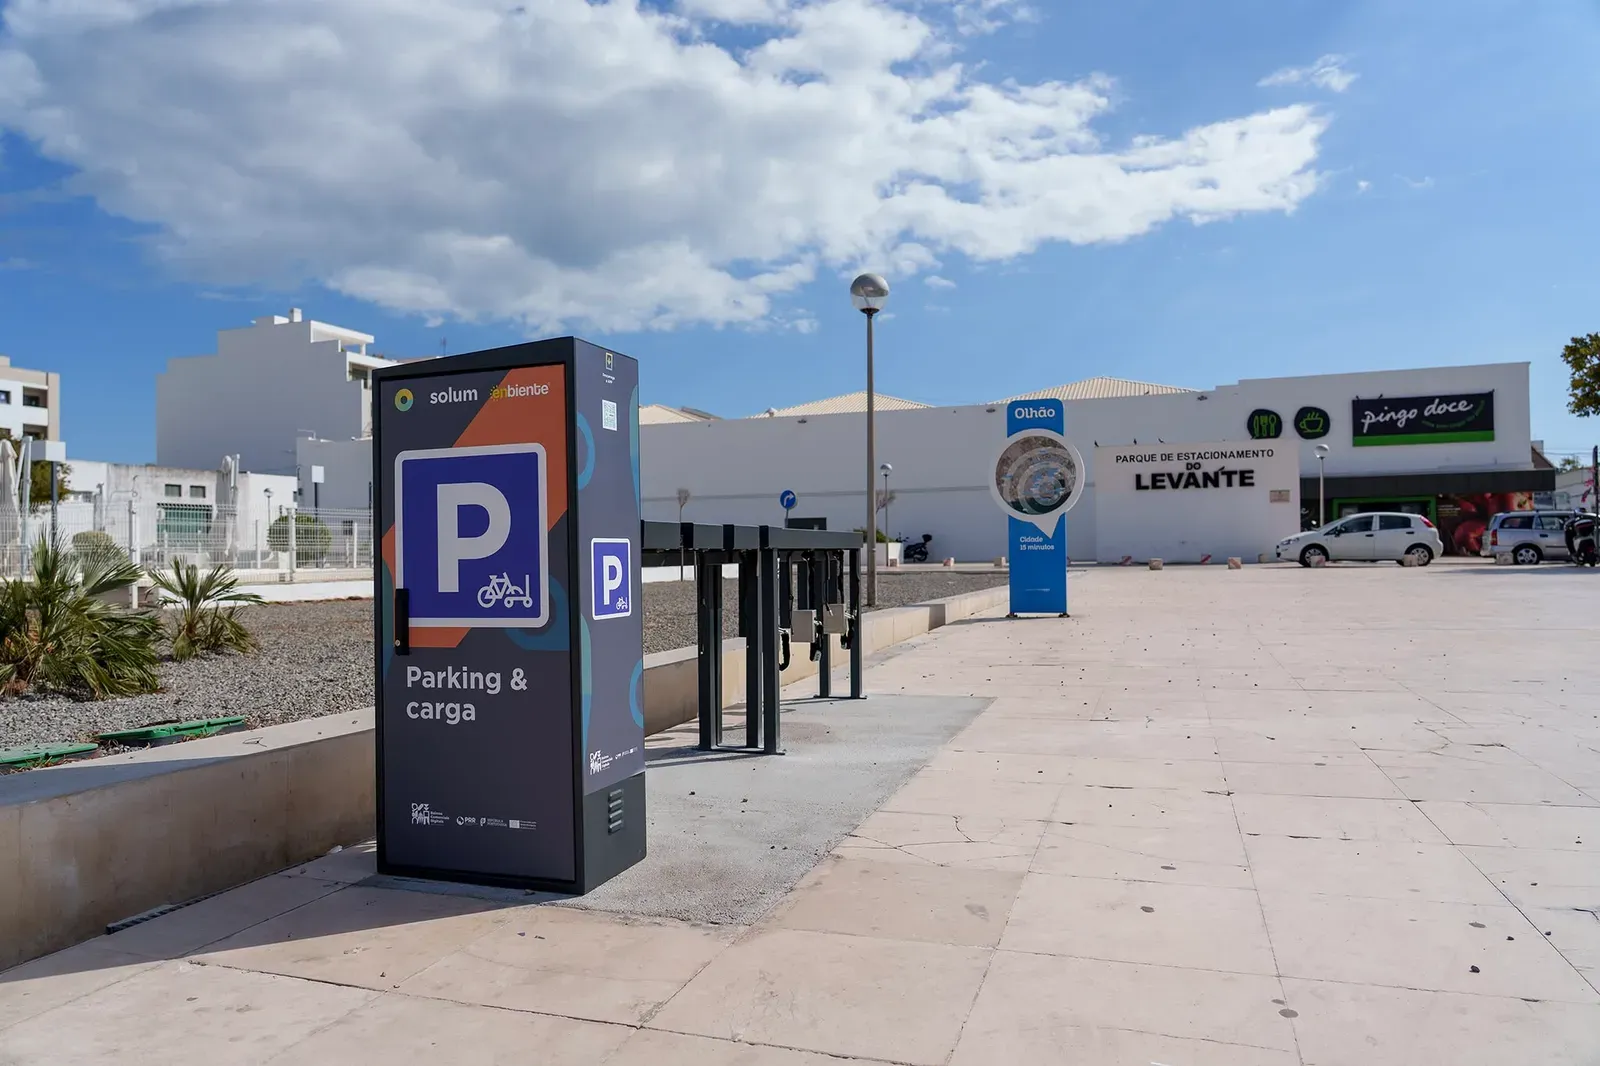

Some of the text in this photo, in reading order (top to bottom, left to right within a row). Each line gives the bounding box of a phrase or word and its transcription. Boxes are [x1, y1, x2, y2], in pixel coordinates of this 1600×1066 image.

[430, 386, 477, 404] solum
[1014, 406, 1056, 419] Olhão
[1361, 406, 1418, 433] pingo
[1424, 398, 1473, 416] doce
[1116, 448, 1274, 463] PARQUE DE ESTACIONAMENTO
[1186, 462, 1202, 471] DO
[437, 482, 511, 593] P
[602, 555, 622, 605] P
[406, 665, 528, 695] Parking &
[406, 701, 476, 725] carga
